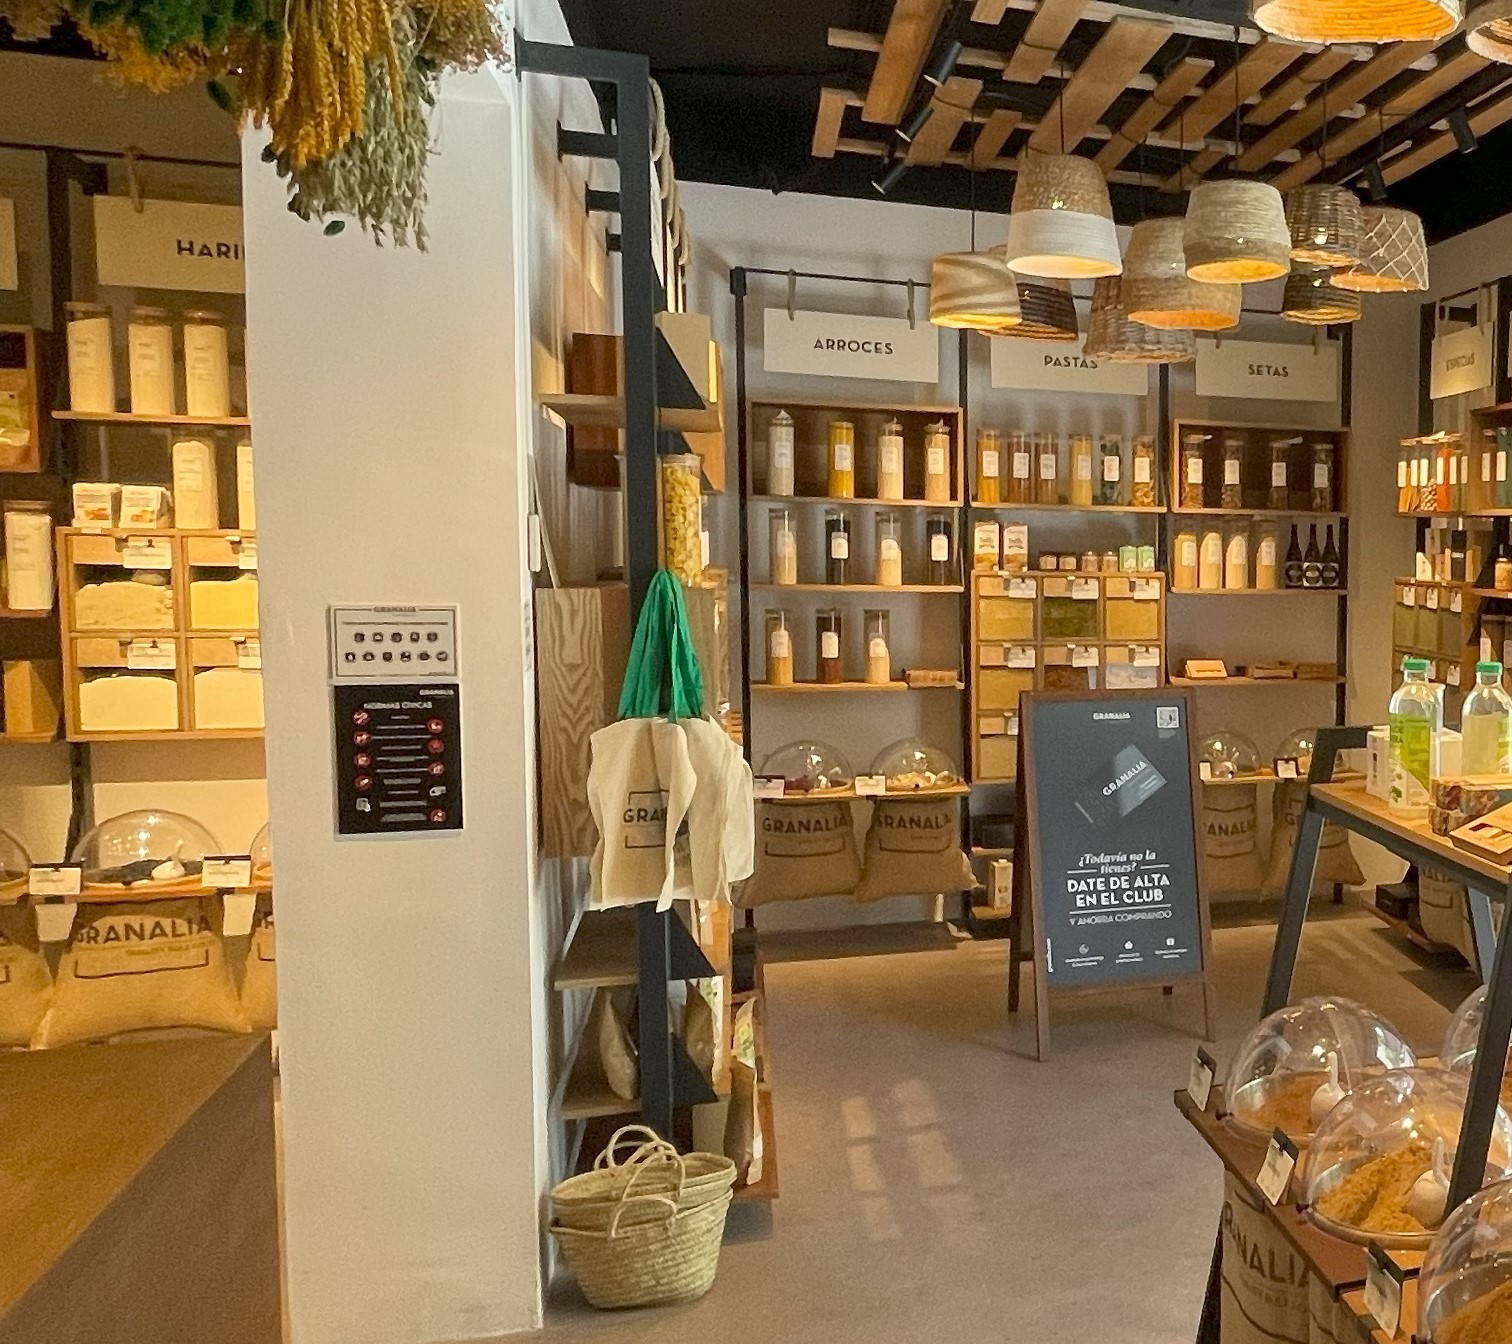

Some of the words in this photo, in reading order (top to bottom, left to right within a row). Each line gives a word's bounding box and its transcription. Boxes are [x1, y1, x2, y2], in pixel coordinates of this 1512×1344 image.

[177, 239, 245, 260] HARI
[813, 338, 894, 355] ARROCES
[1044, 355, 1098, 368] PASTAS
[1248, 364, 1289, 377] SETAS
[1079, 851, 1127, 867] ¿Todavía
[1130, 853, 1143, 861] no
[1146, 849, 1156, 860] la
[1101, 862, 1137, 874] tienes?
[1067, 877, 1106, 893] DATE
[1110, 876, 1130, 890] DE
[1134, 873, 1170, 888] ALTA
[1076, 894, 1097, 907] EN
[1101, 892, 1119, 905] EL
[1123, 889, 1164, 903] CLUB
